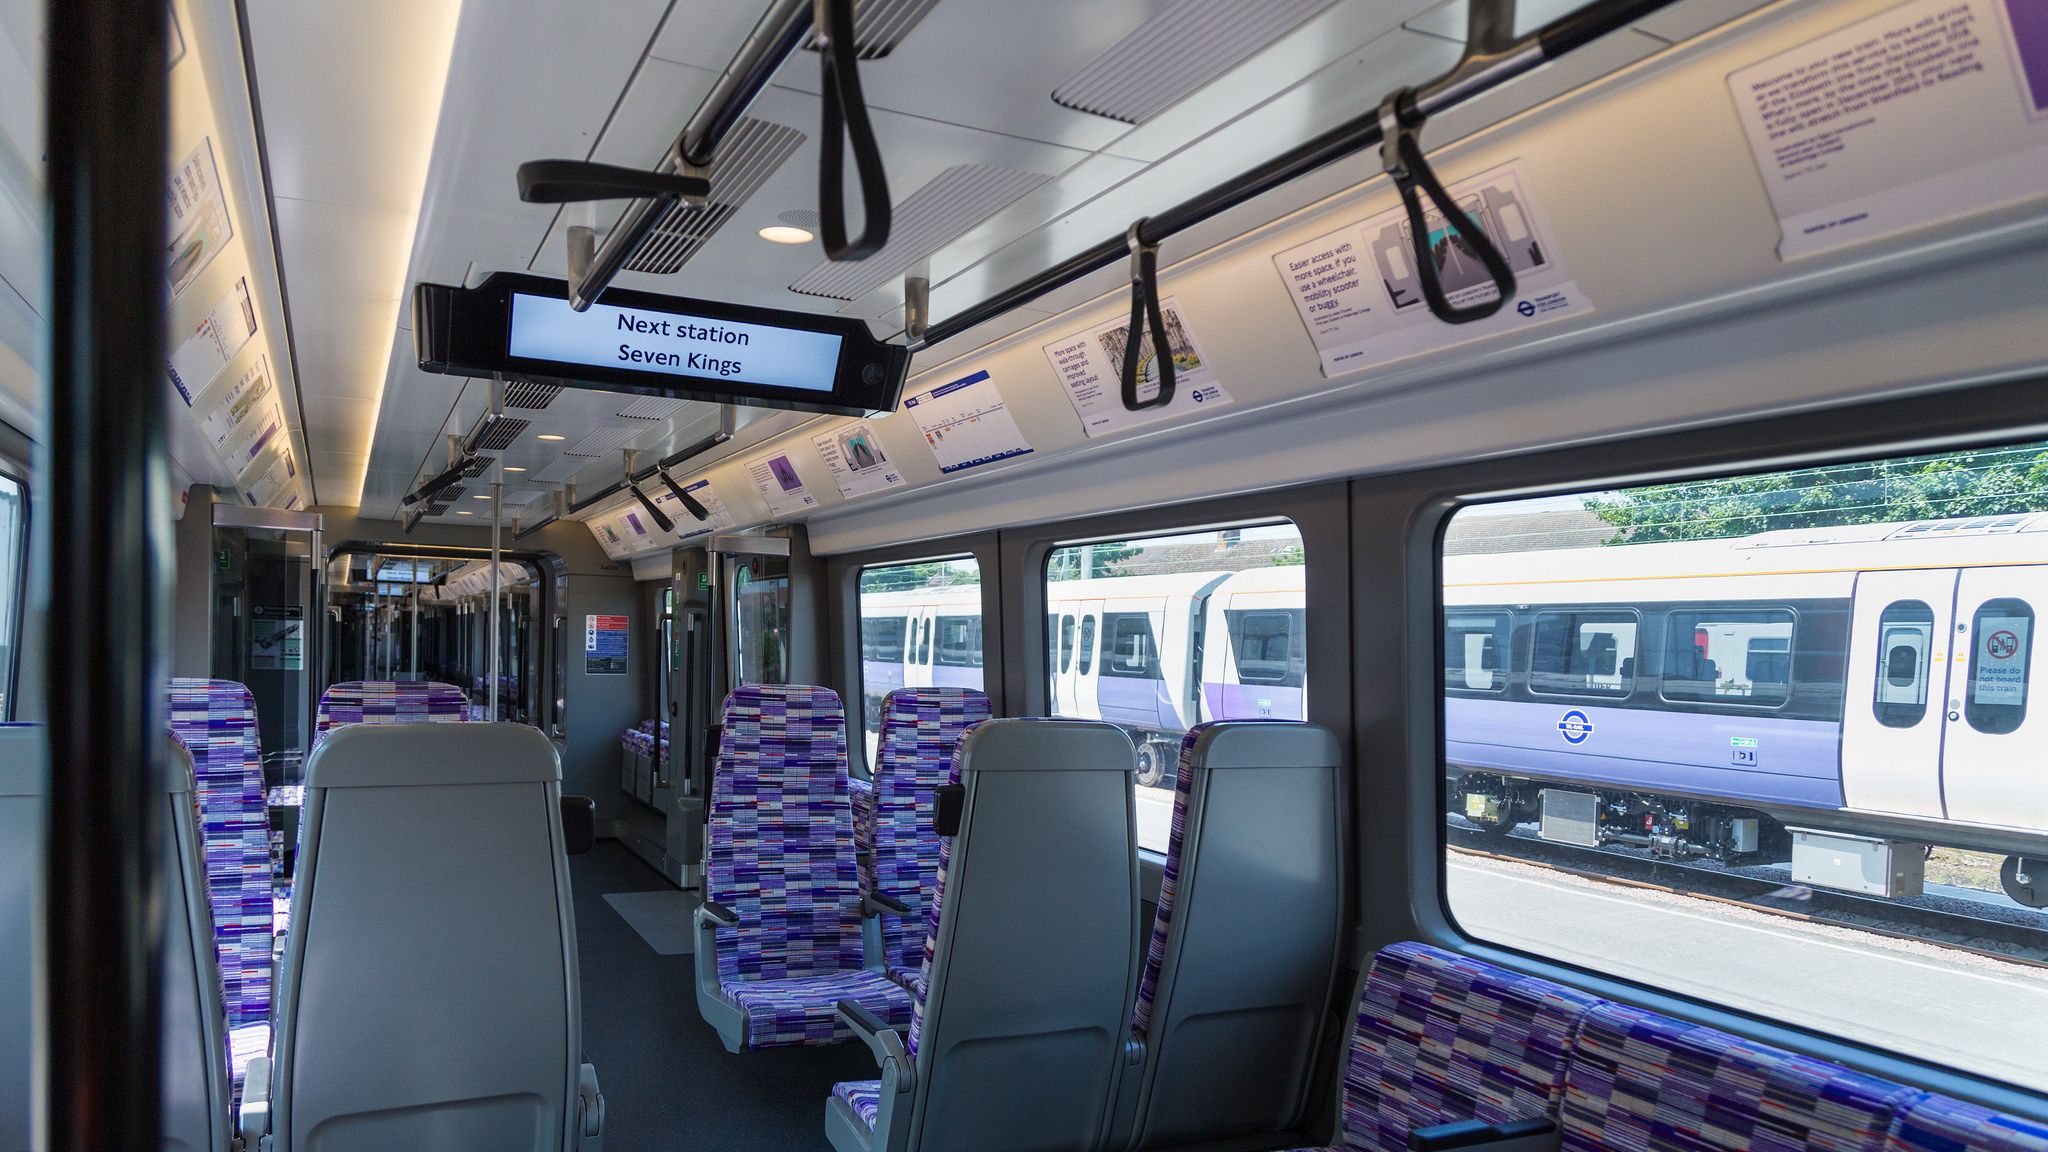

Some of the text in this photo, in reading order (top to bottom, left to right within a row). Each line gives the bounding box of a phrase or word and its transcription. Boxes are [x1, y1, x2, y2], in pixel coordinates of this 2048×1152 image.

[1752, 72, 1794, 91] Welcome
[1289, 242, 1353, 271] Easier access with
[1294, 271, 1312, 281] more
[1342, 255, 1357, 267] you
[1299, 283, 1311, 292] use
[1304, 279, 1360, 303] mobility scooter
[617, 313, 750, 346] Next station
[618, 344, 742, 377] Seven Kings
[1980, 666, 2021, 674] Please do
[1996, 675, 2022, 683] board
[1978, 684, 2017, 692] this train
